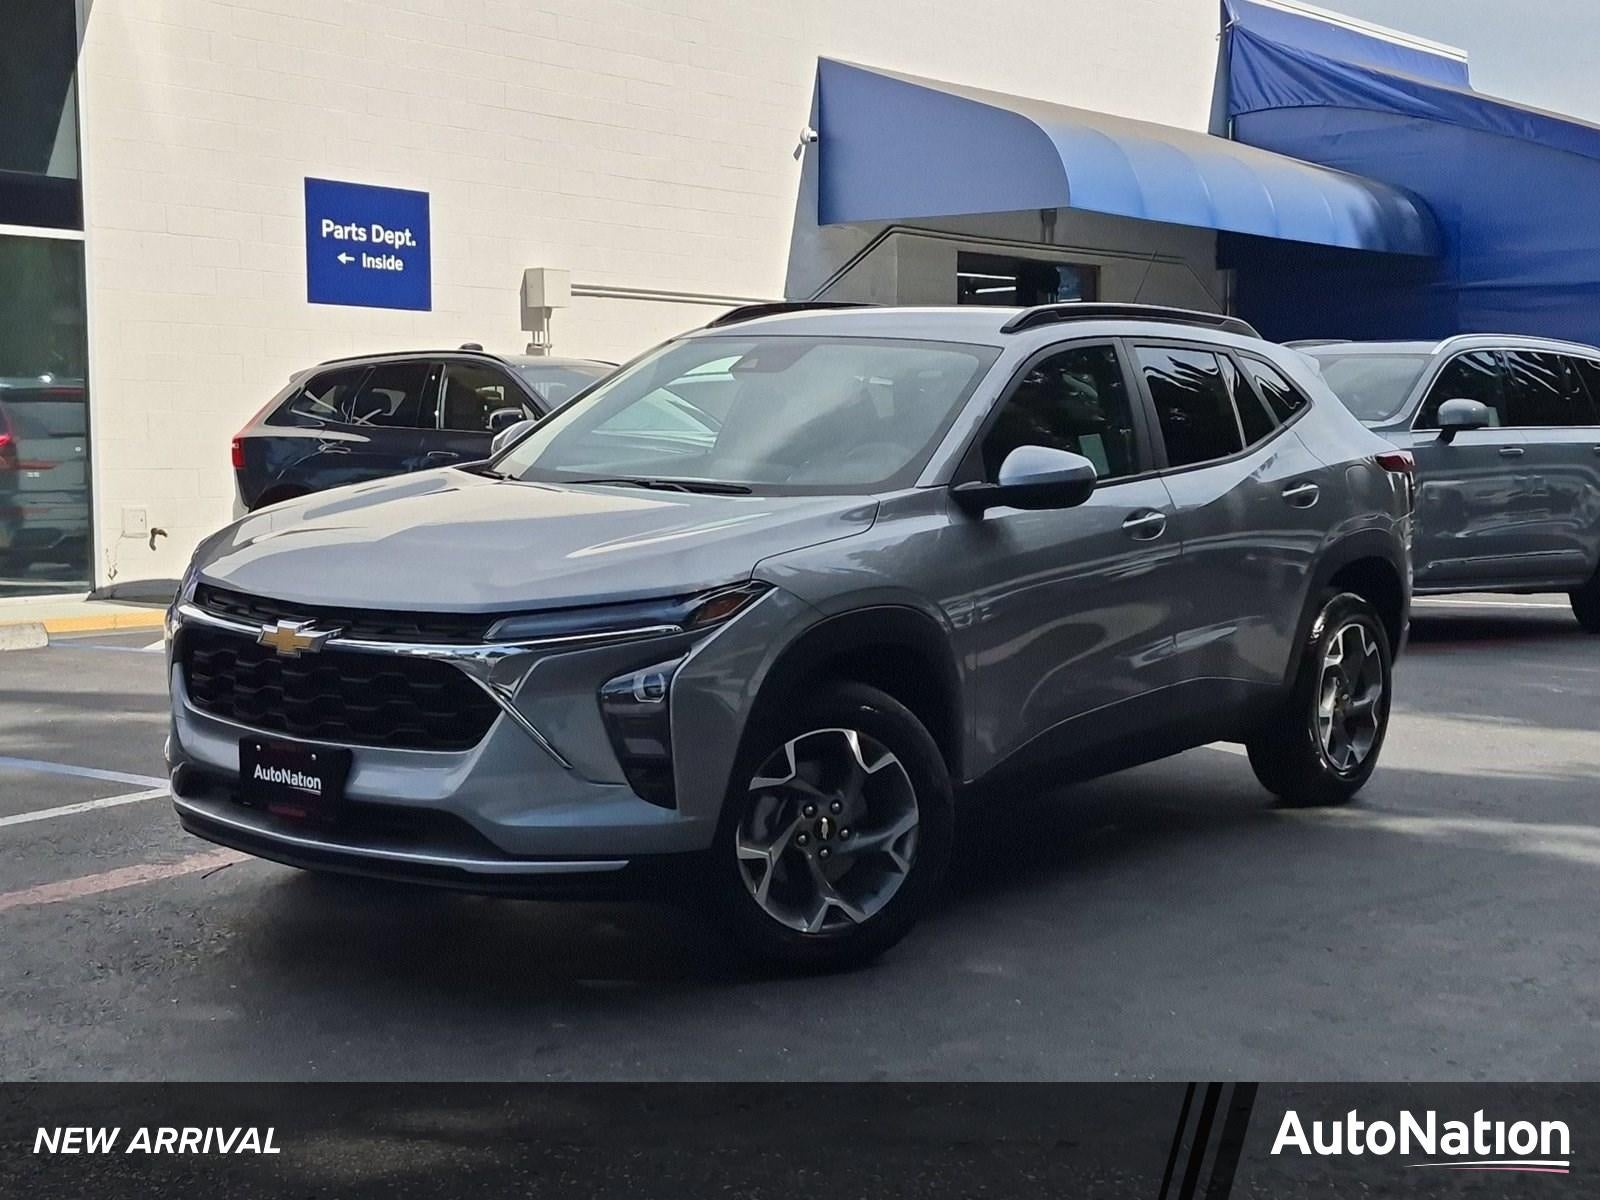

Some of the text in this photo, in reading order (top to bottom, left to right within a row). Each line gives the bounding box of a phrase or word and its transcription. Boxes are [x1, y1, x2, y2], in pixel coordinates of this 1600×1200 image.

[321, 218, 417, 249] Parts Dept.
[361, 252, 404, 271] Inside
[253, 763, 322, 790] AutoNation
